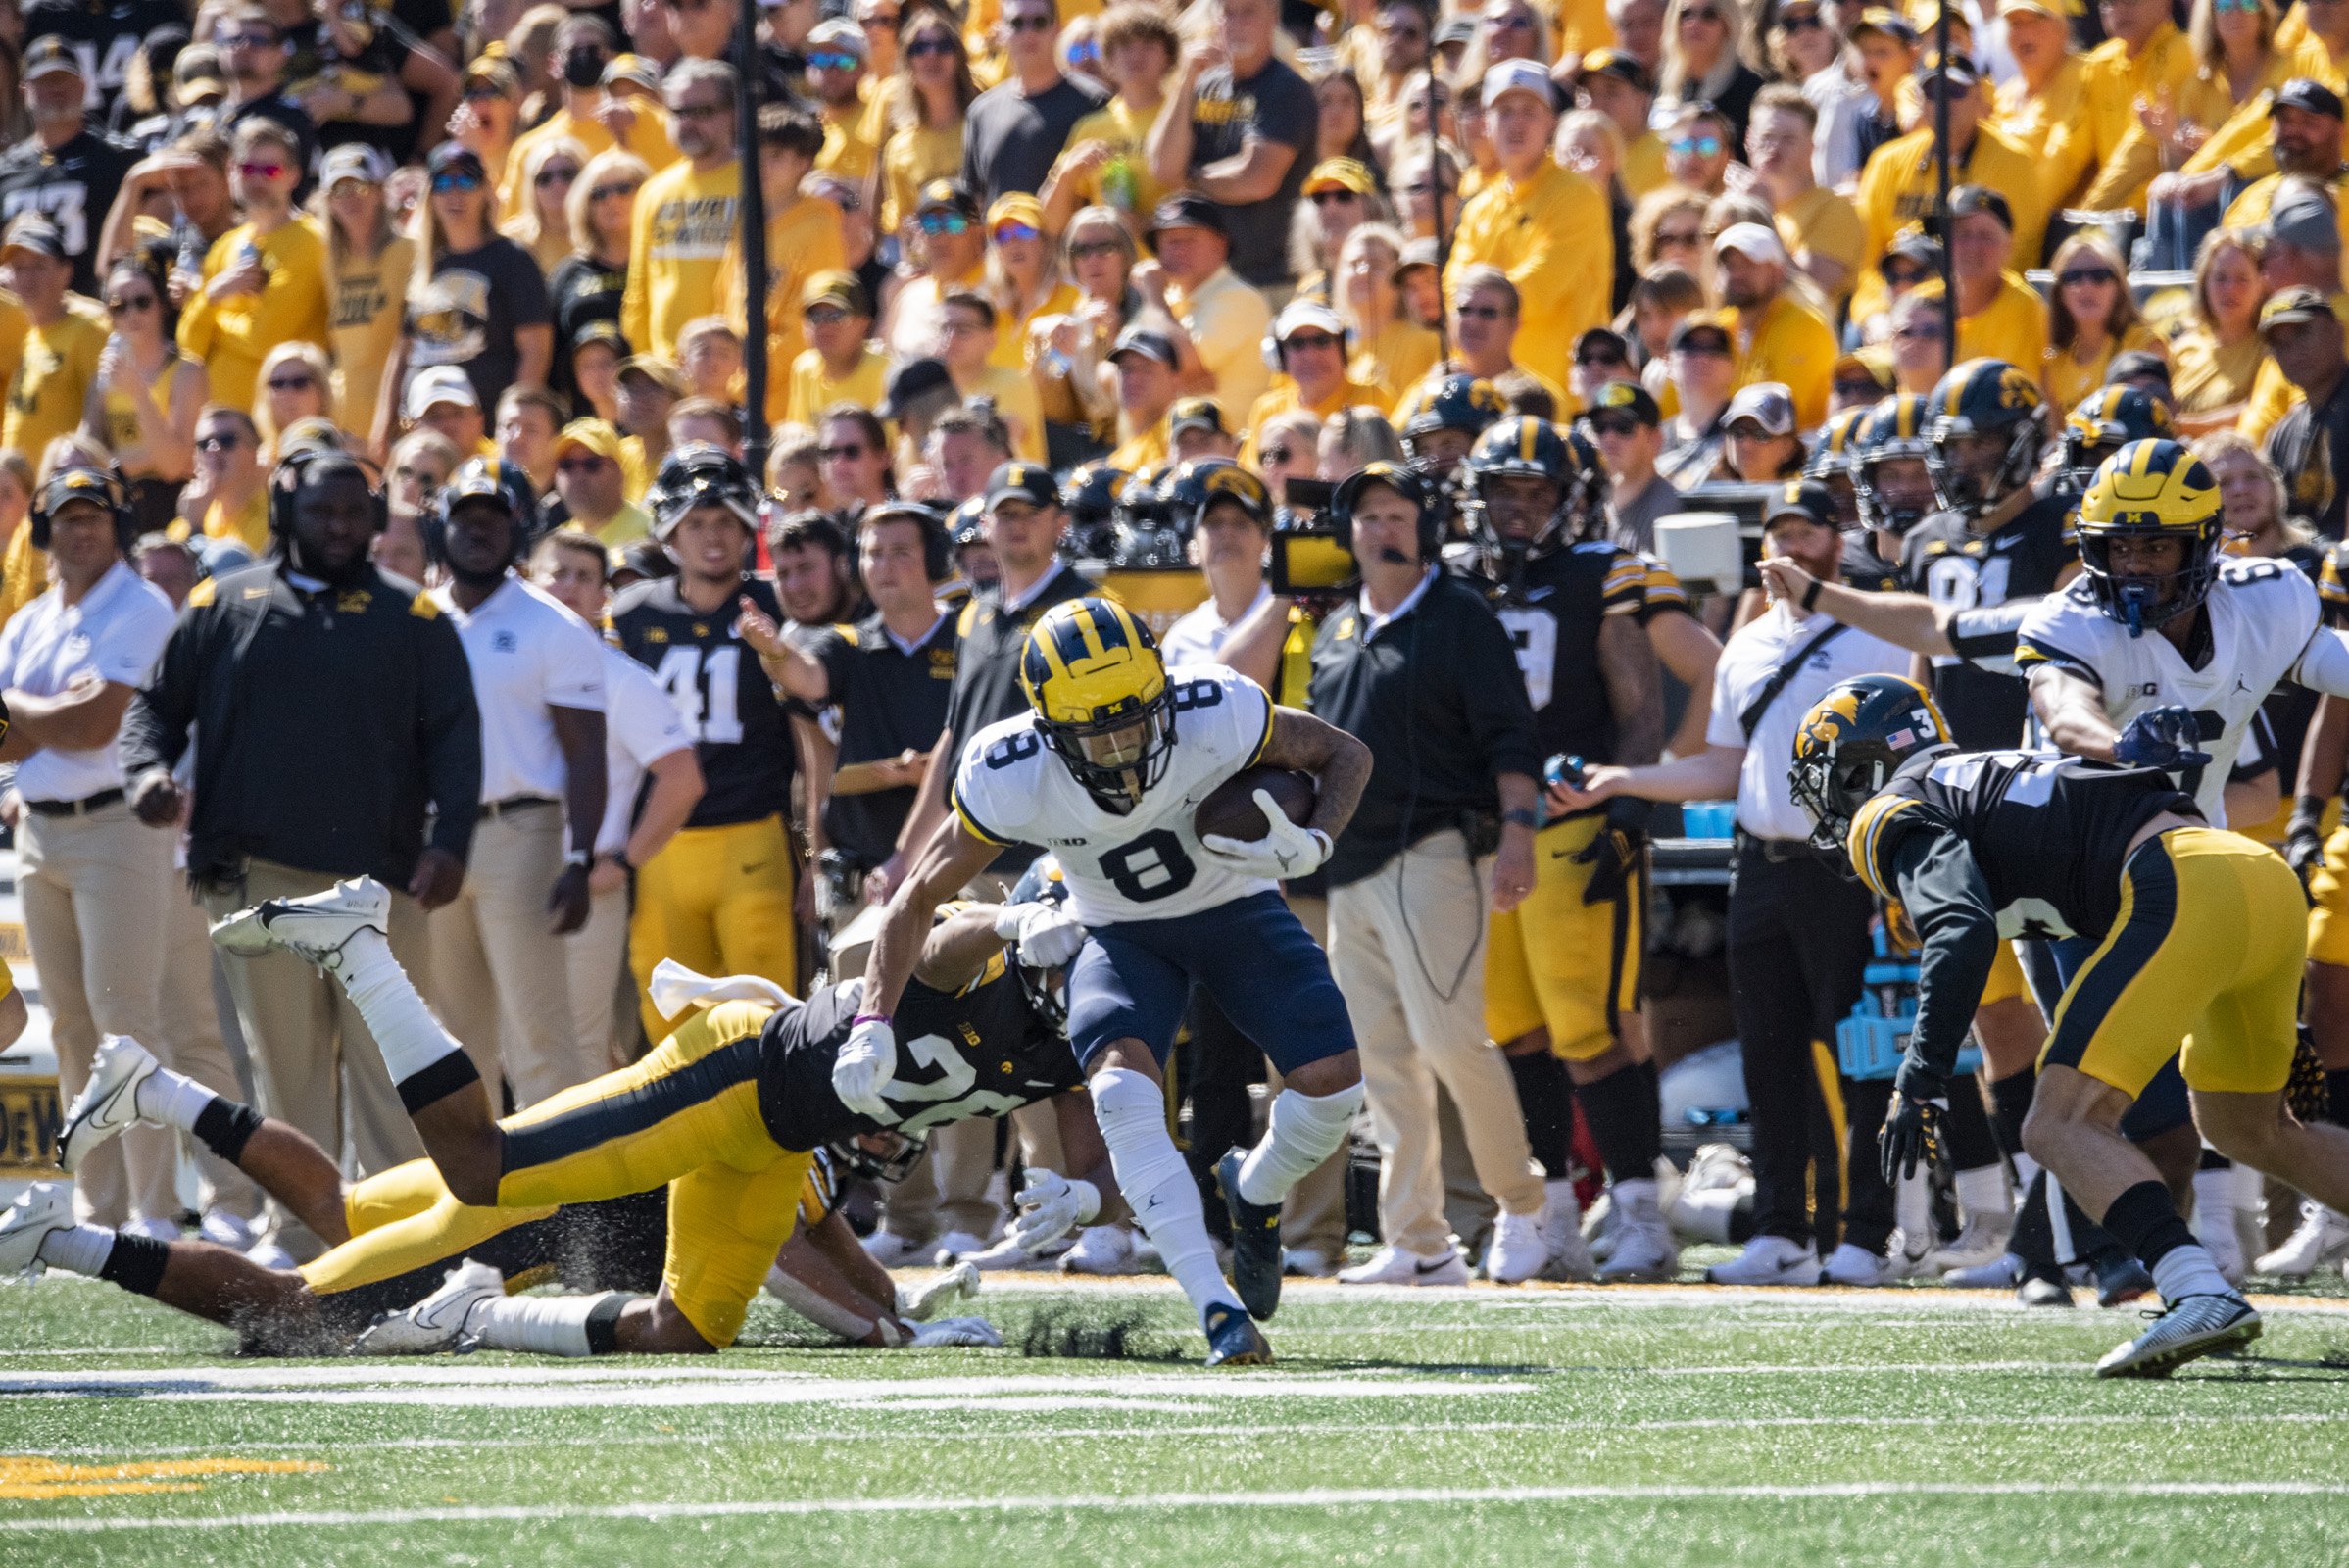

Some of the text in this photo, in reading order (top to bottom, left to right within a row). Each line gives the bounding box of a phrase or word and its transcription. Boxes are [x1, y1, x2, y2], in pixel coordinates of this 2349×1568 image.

[653, 645, 744, 743] 41
[1176, 679, 1223, 712] 8
[1910, 708, 1937, 739] 3
[985, 730, 1039, 770] 8
[1098, 828, 1197, 903] 8
